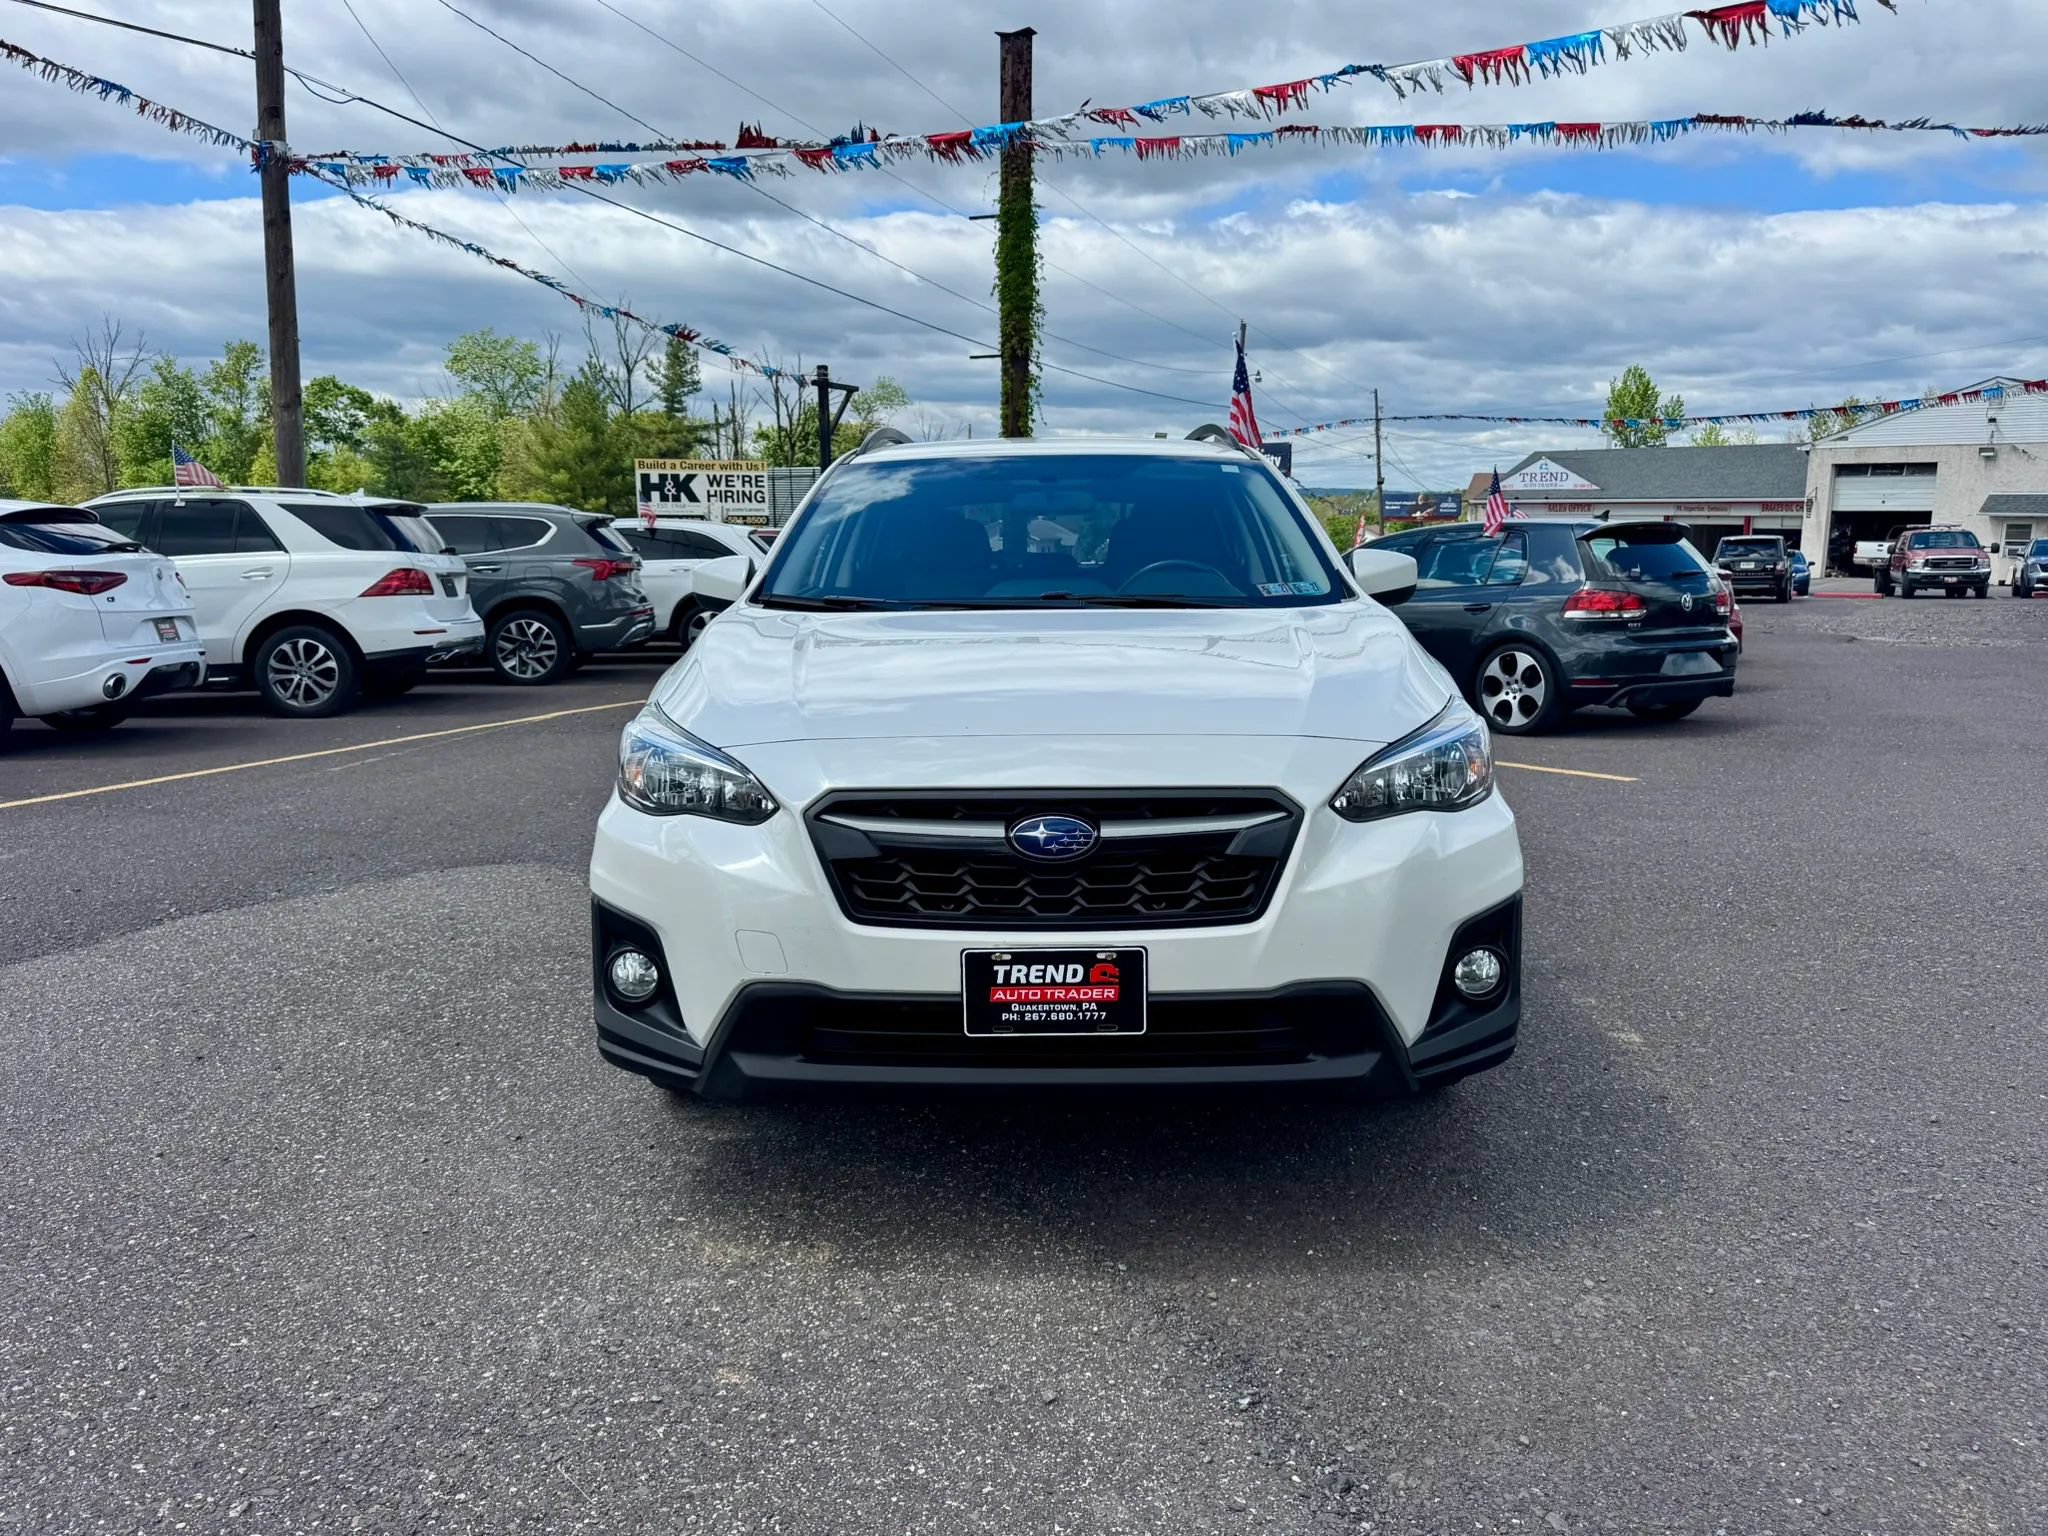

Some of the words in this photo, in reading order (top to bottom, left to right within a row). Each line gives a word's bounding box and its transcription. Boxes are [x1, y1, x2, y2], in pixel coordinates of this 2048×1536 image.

[638, 461, 666, 470] Build
[680, 461, 716, 471] Career
[719, 462, 743, 471] with
[706, 474, 766, 488] WE'RE
[1519, 471, 1569, 482] TREND
[640, 473, 702, 503] H&K
[707, 490, 766, 504] HIRING
[1547, 503, 1567, 512] SALES
[1568, 503, 1592, 512] OFFICE
[993, 964, 1085, 984] TREND
[993, 989, 1041, 1000] AUTO
[1044, 988, 1115, 999] TRADER
[1082, 1002, 1098, 1011] PA
[1002, 1013, 1021, 1021] PH:
[1024, 1012, 1107, 1021] 267.680.1777
